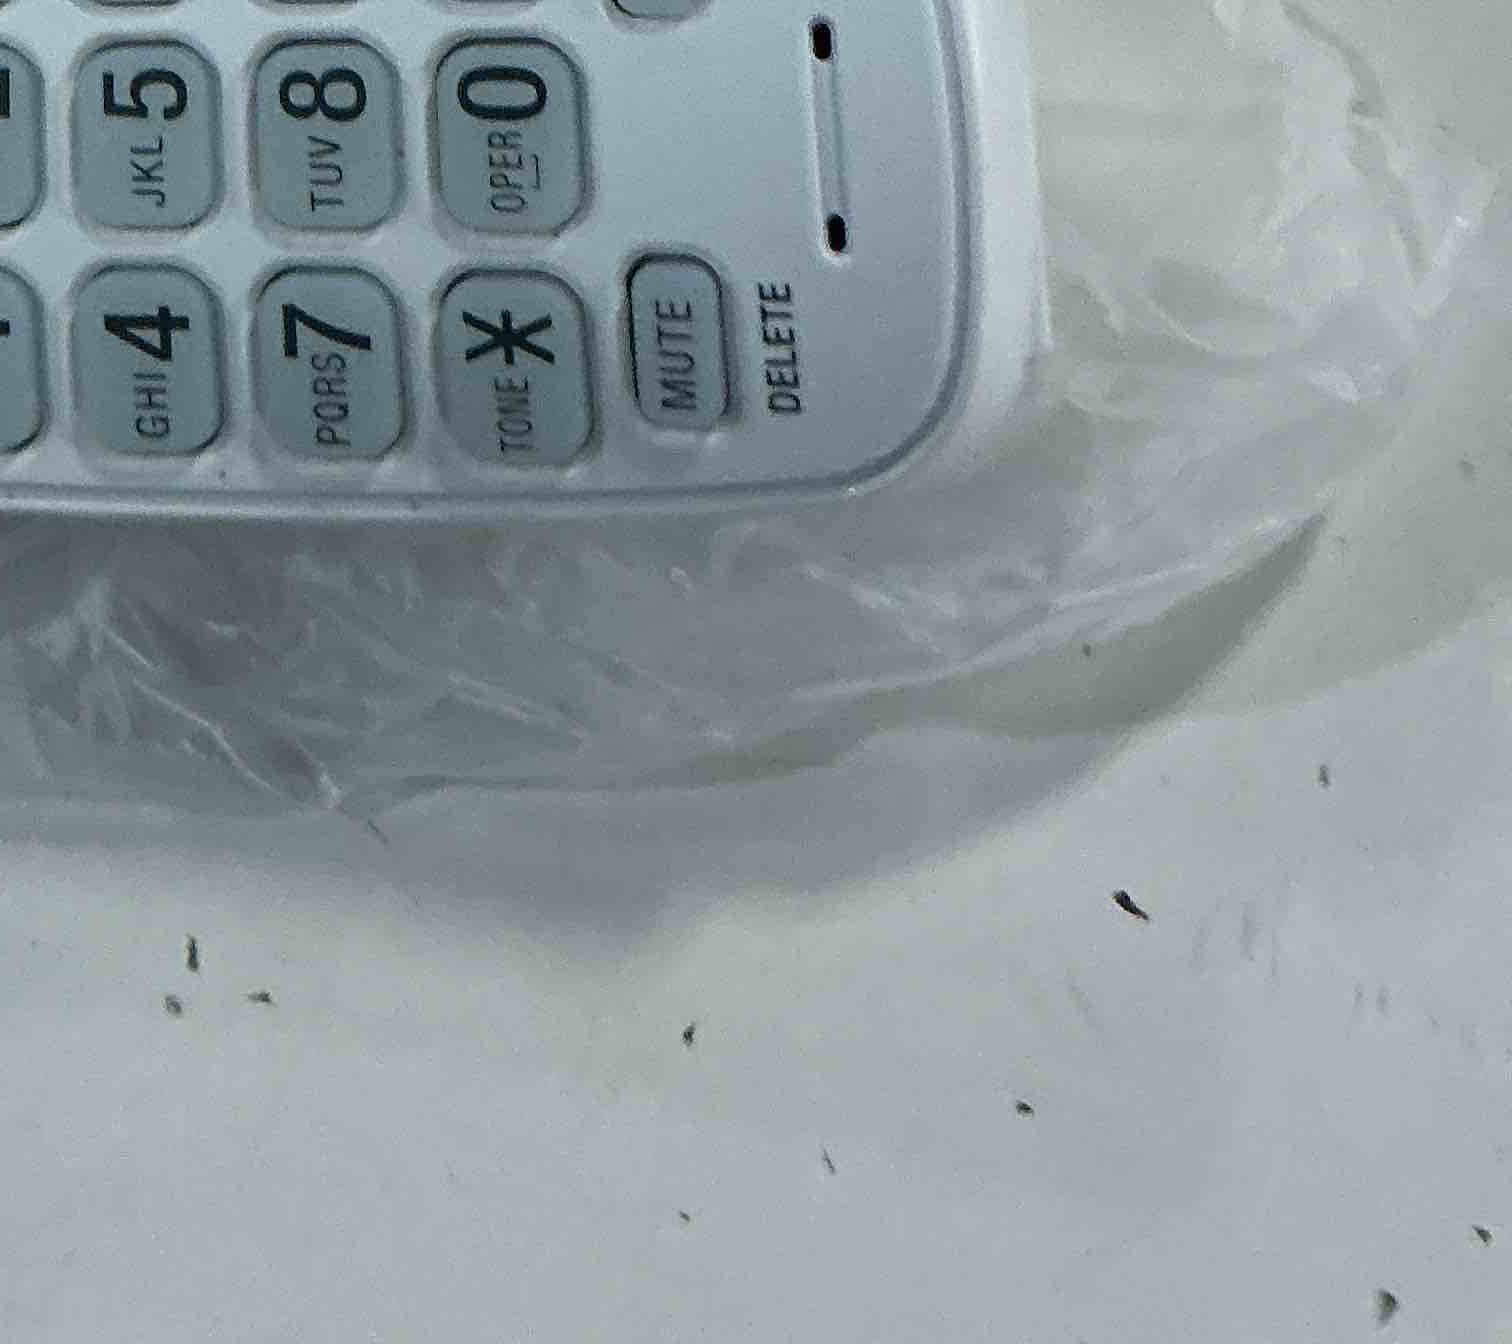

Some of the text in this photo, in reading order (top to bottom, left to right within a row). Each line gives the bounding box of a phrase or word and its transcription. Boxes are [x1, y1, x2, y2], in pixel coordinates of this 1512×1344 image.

[101, 67, 188, 208] JKL 5
[278, 67, 368, 212] TUV 8
[456, 65, 548, 214] OPER 0
[103, 304, 190, 440] GHI 4
[282, 302, 373, 449] PQRS 7
[494, 374, 535, 454] TONE
[654, 298, 698, 413] MUTE
[757, 280, 803, 417] DELETE
